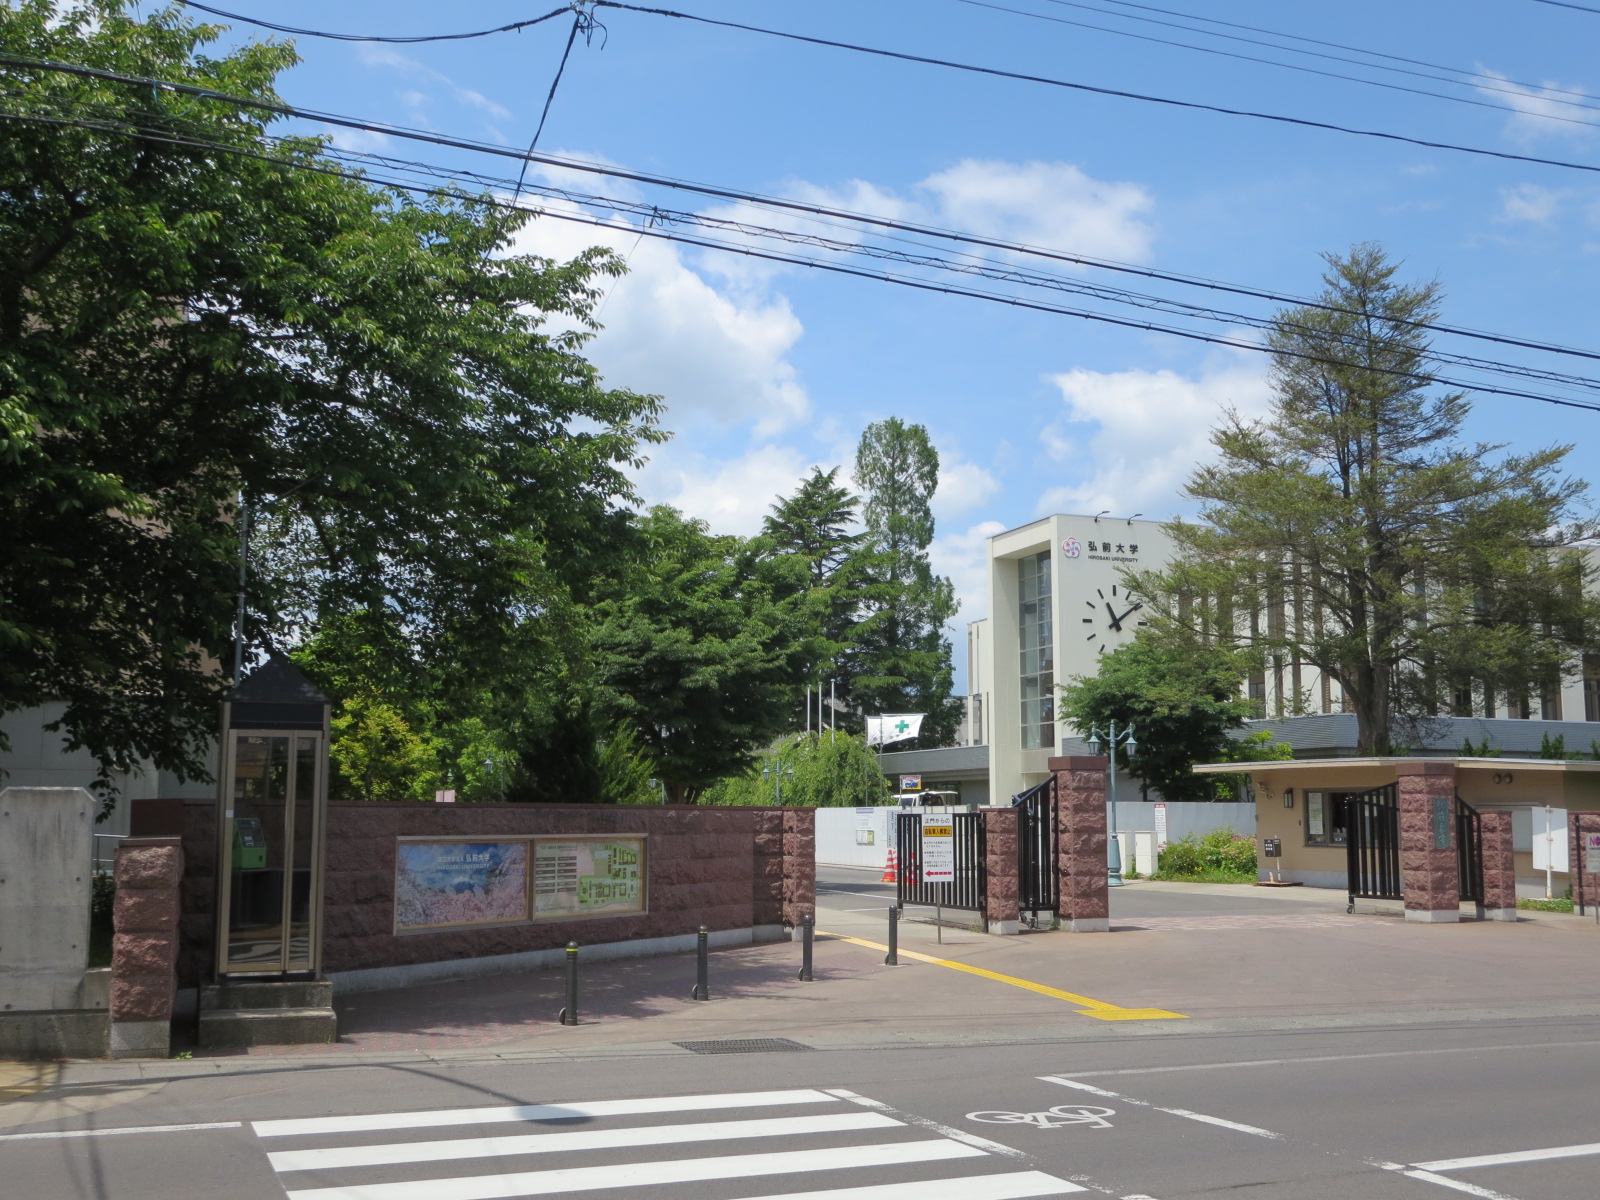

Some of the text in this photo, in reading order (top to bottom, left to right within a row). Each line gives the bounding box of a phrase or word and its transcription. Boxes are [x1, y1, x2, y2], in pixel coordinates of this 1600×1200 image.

[1088, 541, 1139, 555] 弘前大学
[465, 853, 490, 862] 弘前大学
